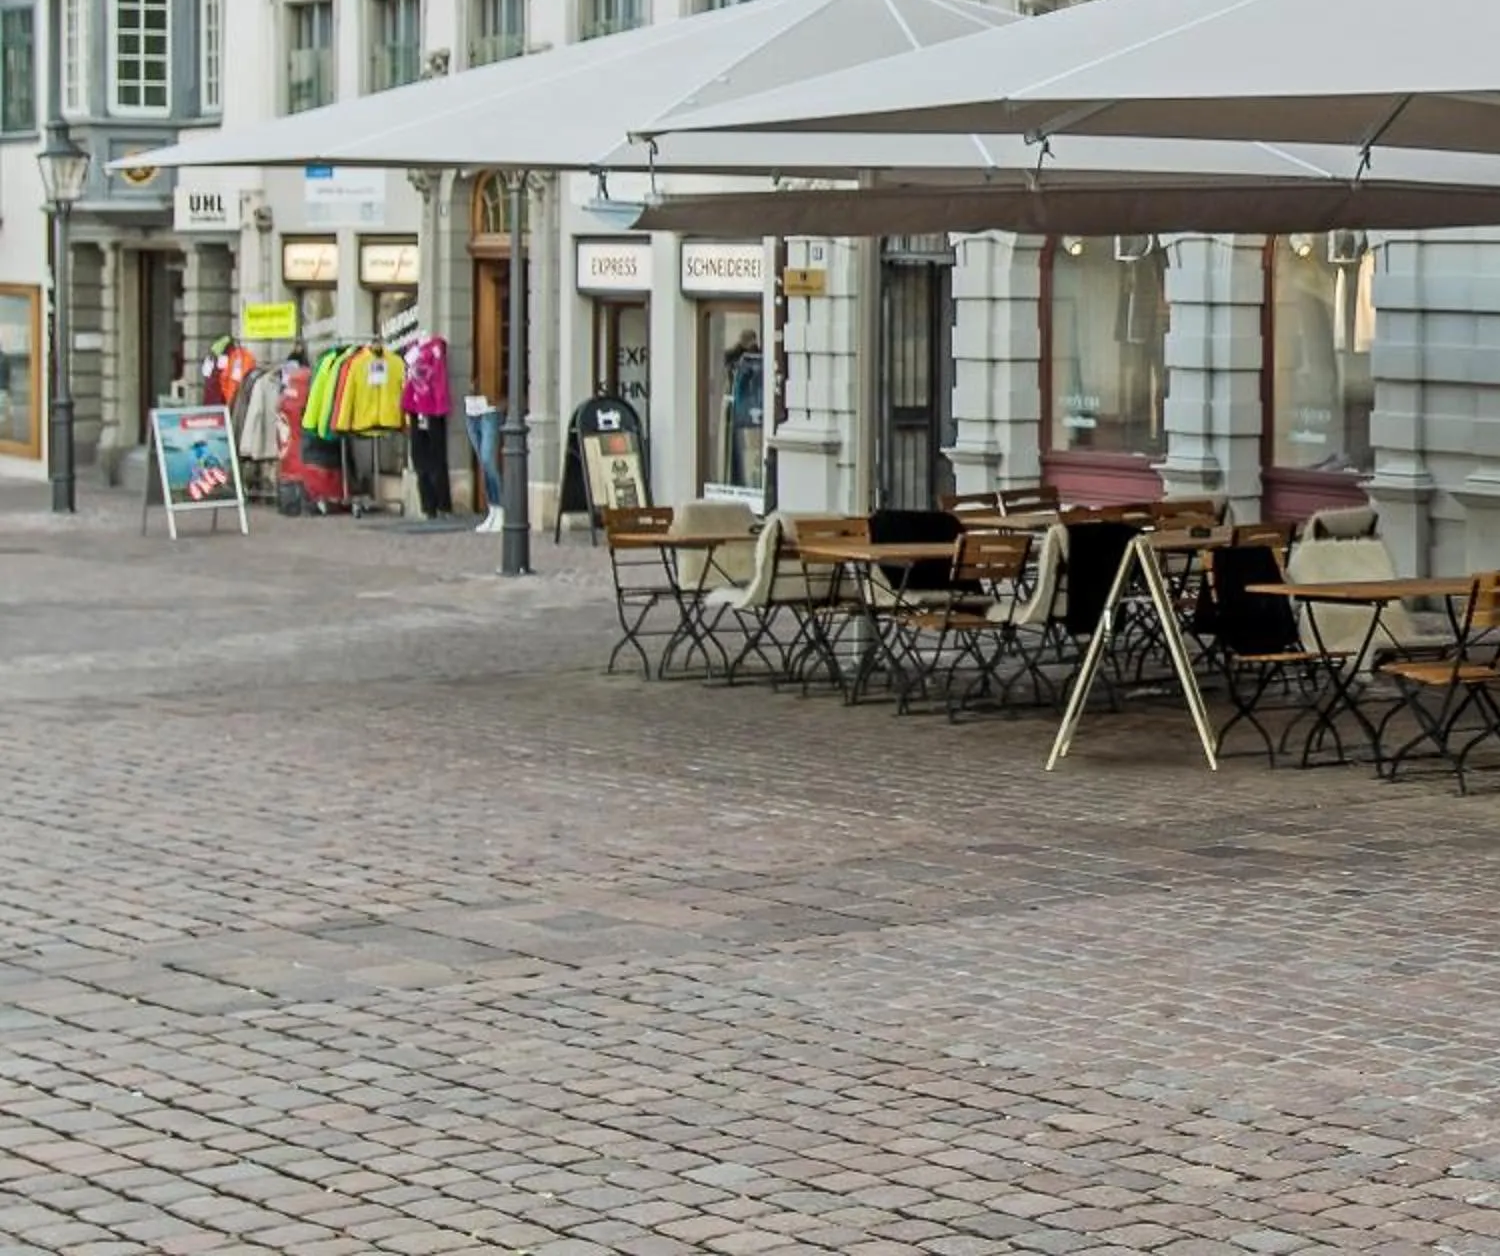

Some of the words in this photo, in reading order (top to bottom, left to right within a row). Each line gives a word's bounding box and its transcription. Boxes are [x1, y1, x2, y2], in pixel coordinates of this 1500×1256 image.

[189, 194, 225, 213] UHL
[591, 257, 637, 277] EXPRESS
[687, 256, 762, 278] SCHNEIDEREI
